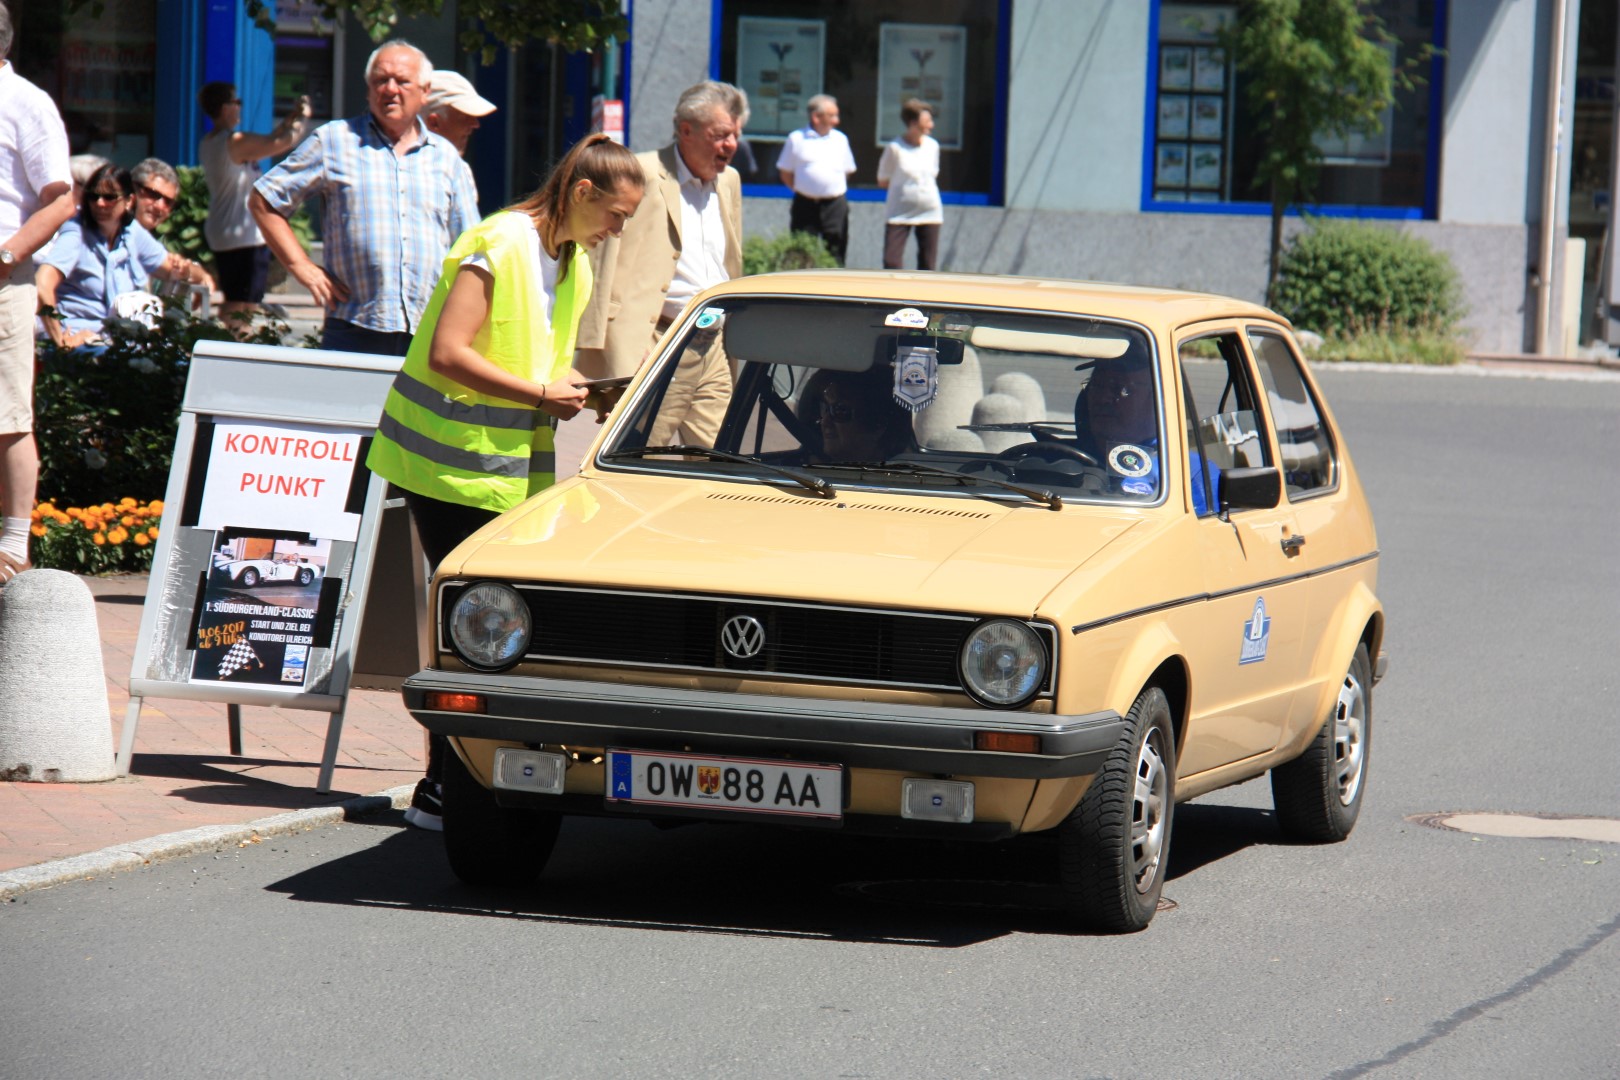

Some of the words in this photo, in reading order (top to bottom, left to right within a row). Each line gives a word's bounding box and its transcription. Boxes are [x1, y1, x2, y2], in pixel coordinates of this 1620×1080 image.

[224, 432, 353, 462] KONTROLL
[240, 472, 325, 498] PUNKT
[205, 601, 212, 612] 1.
[213, 601, 315, 619] SÜDBURGENLAND-CLASSIC
[250, 619, 269, 630] START
[271, 621, 285, 631] UND
[285, 622, 299, 632] ZIEL
[299, 623, 311, 633] BEI
[721, 615, 765, 658] VW
[248, 632, 286, 643] KONDITOREI
[286, 634, 313, 645] ULREICH
[617, 781, 627, 792] A
[647, 761, 693, 798] OW
[723, 767, 764, 803] 88
[774, 771, 821, 808] AA
